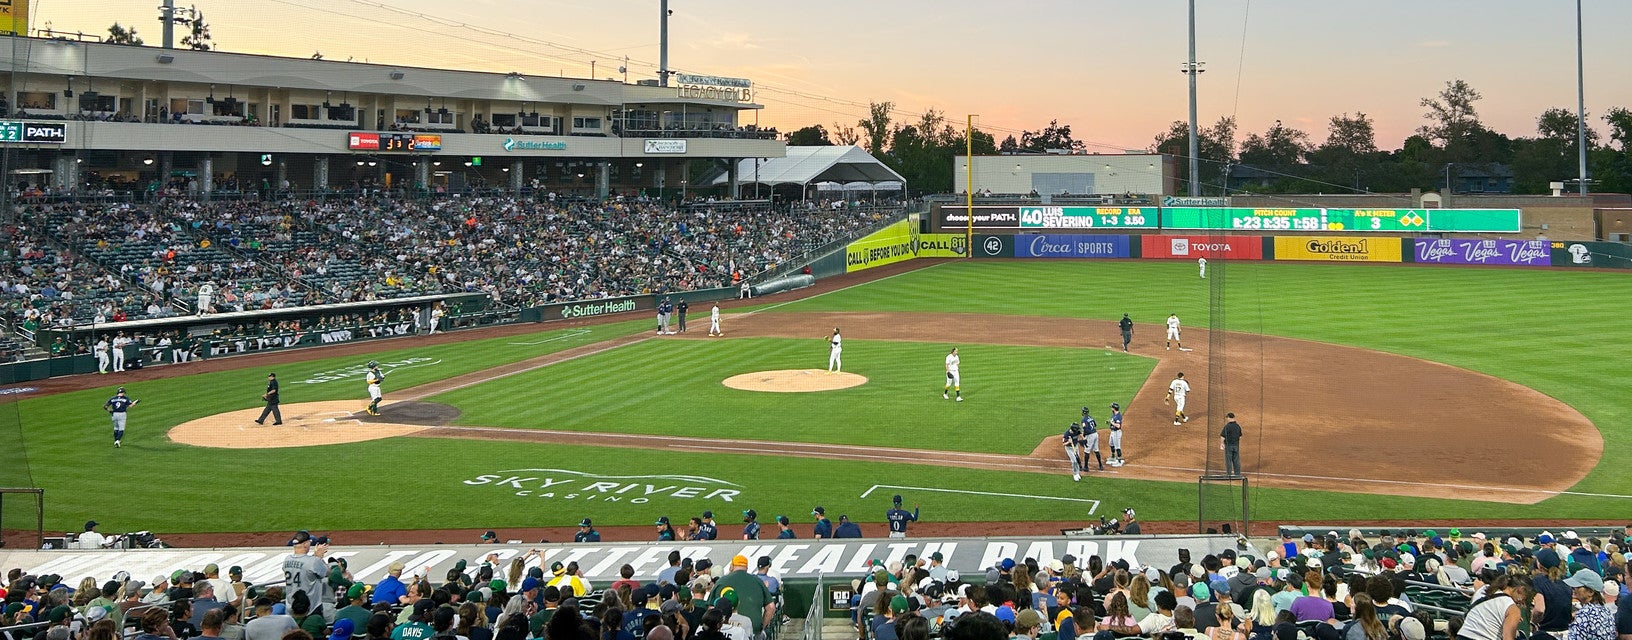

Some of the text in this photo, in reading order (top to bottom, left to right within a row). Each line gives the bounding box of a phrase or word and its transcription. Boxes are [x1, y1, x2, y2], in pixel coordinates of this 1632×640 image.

[678, 84, 751, 101] LEGACY CLUB
[8, 131, 16, 139] 2
[27, 127, 64, 138] PATH.
[517, 140, 567, 150] Sutter Health
[1176, 198, 1230, 206] Sutter Health
[990, 213, 1017, 221] PATH.
[1022, 209, 1042, 224] 40
[1043, 207, 1063, 216] LUIS
[1042, 216, 1093, 228] SEVERINO
[1101, 216, 1145, 225] 1-3 3.50
[1232, 217, 1261, 229] B:23
[1292, 217, 1318, 229] T:58
[1370, 217, 1381, 229] 3
[920, 237, 966, 250] CALL 811
[987, 240, 999, 251] 42
[1030, 235, 1113, 257] Circa SPORTS
[1191, 243, 1232, 252] TOYOTA
[848, 251, 863, 266] CALL
[870, 246, 890, 261] BEFORE
[891, 244, 900, 258] YOU
[901, 243, 909, 255] DIG
[1415, 240, 1457, 262] Vegas
[1460, 241, 1503, 263] Vegas
[1505, 241, 1550, 264] Vegas
[573, 300, 636, 317] Sutter Health
[115, 401, 121, 409] 9
[463, 474, 741, 502] SKY RIVER
[515, 490, 650, 504] CASINO
[893, 520, 900, 531] 0
[350, 548, 457, 582] TO
[447, 546, 712, 583] SUTTER
[724, 542, 958, 575] HEALTH
[977, 540, 1141, 572] PARK
[284, 571, 301, 587] 24
[402, 626, 424, 637] DAVIS
